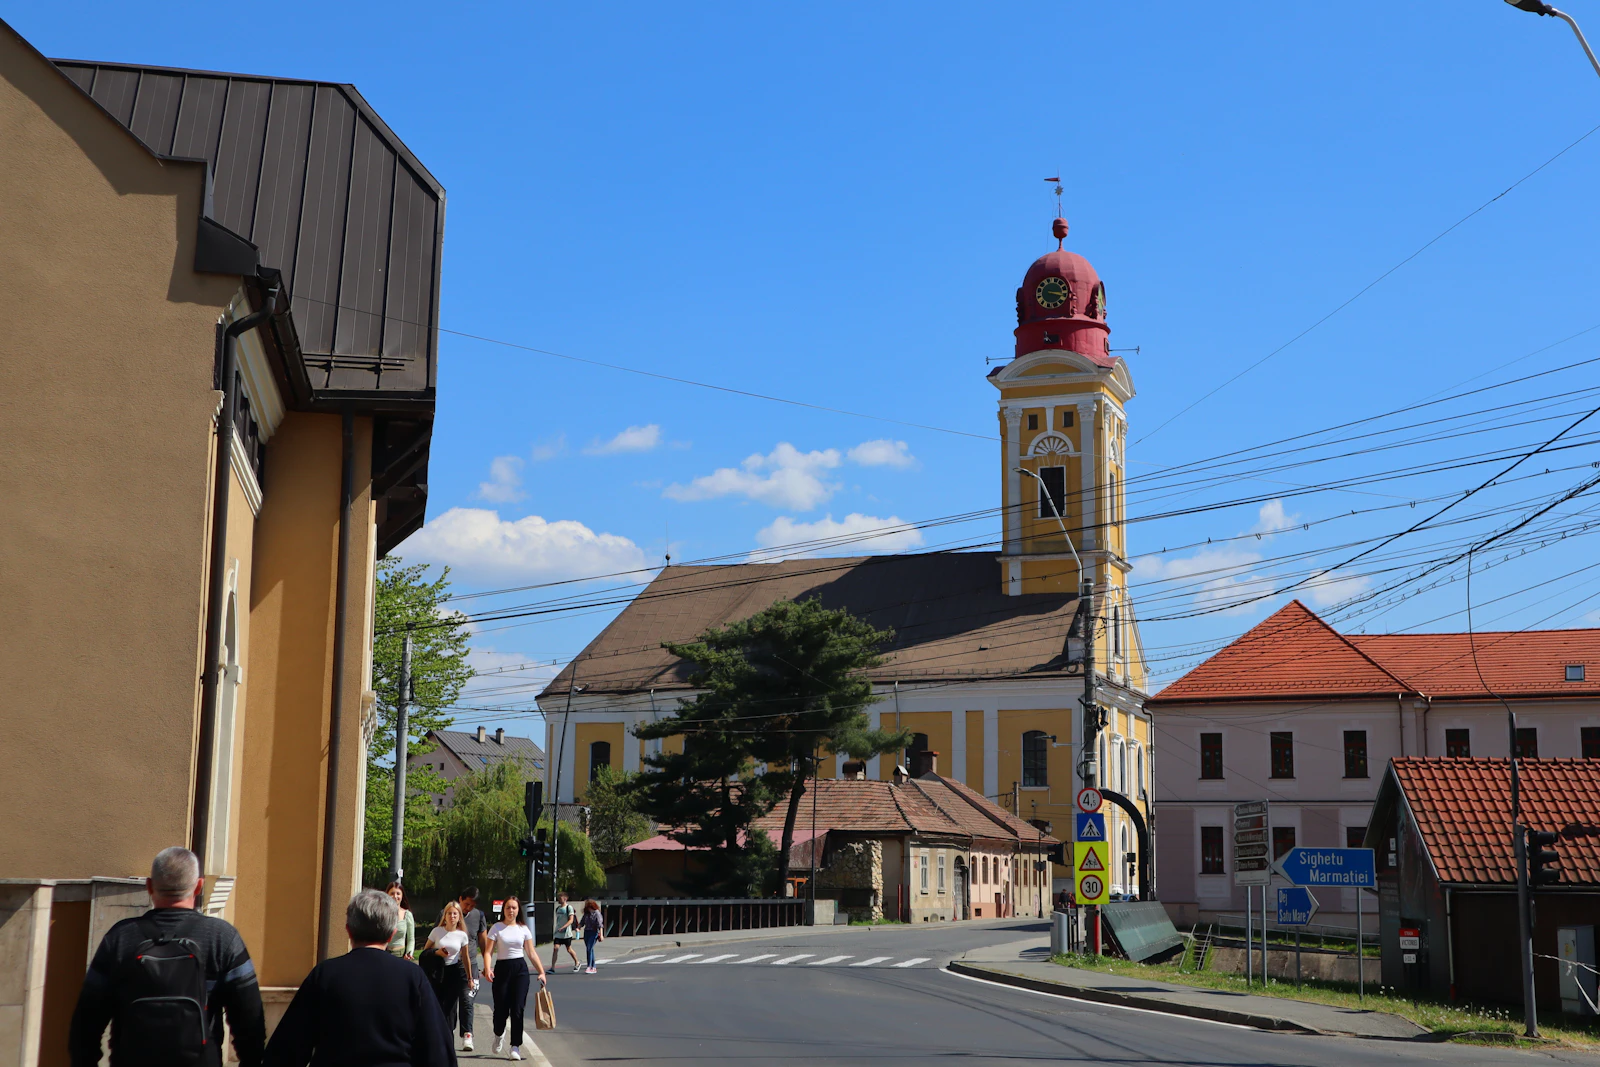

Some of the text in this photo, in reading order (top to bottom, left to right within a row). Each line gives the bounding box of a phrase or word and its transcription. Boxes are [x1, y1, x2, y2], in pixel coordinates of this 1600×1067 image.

[1299, 851, 1343, 869] Sighetu
[1309, 869, 1369, 885] Marmației
[1085, 881, 1098, 894] 30
[1279, 890, 1288, 907] Dej
[1279, 908, 1307, 922] Satu Mare
